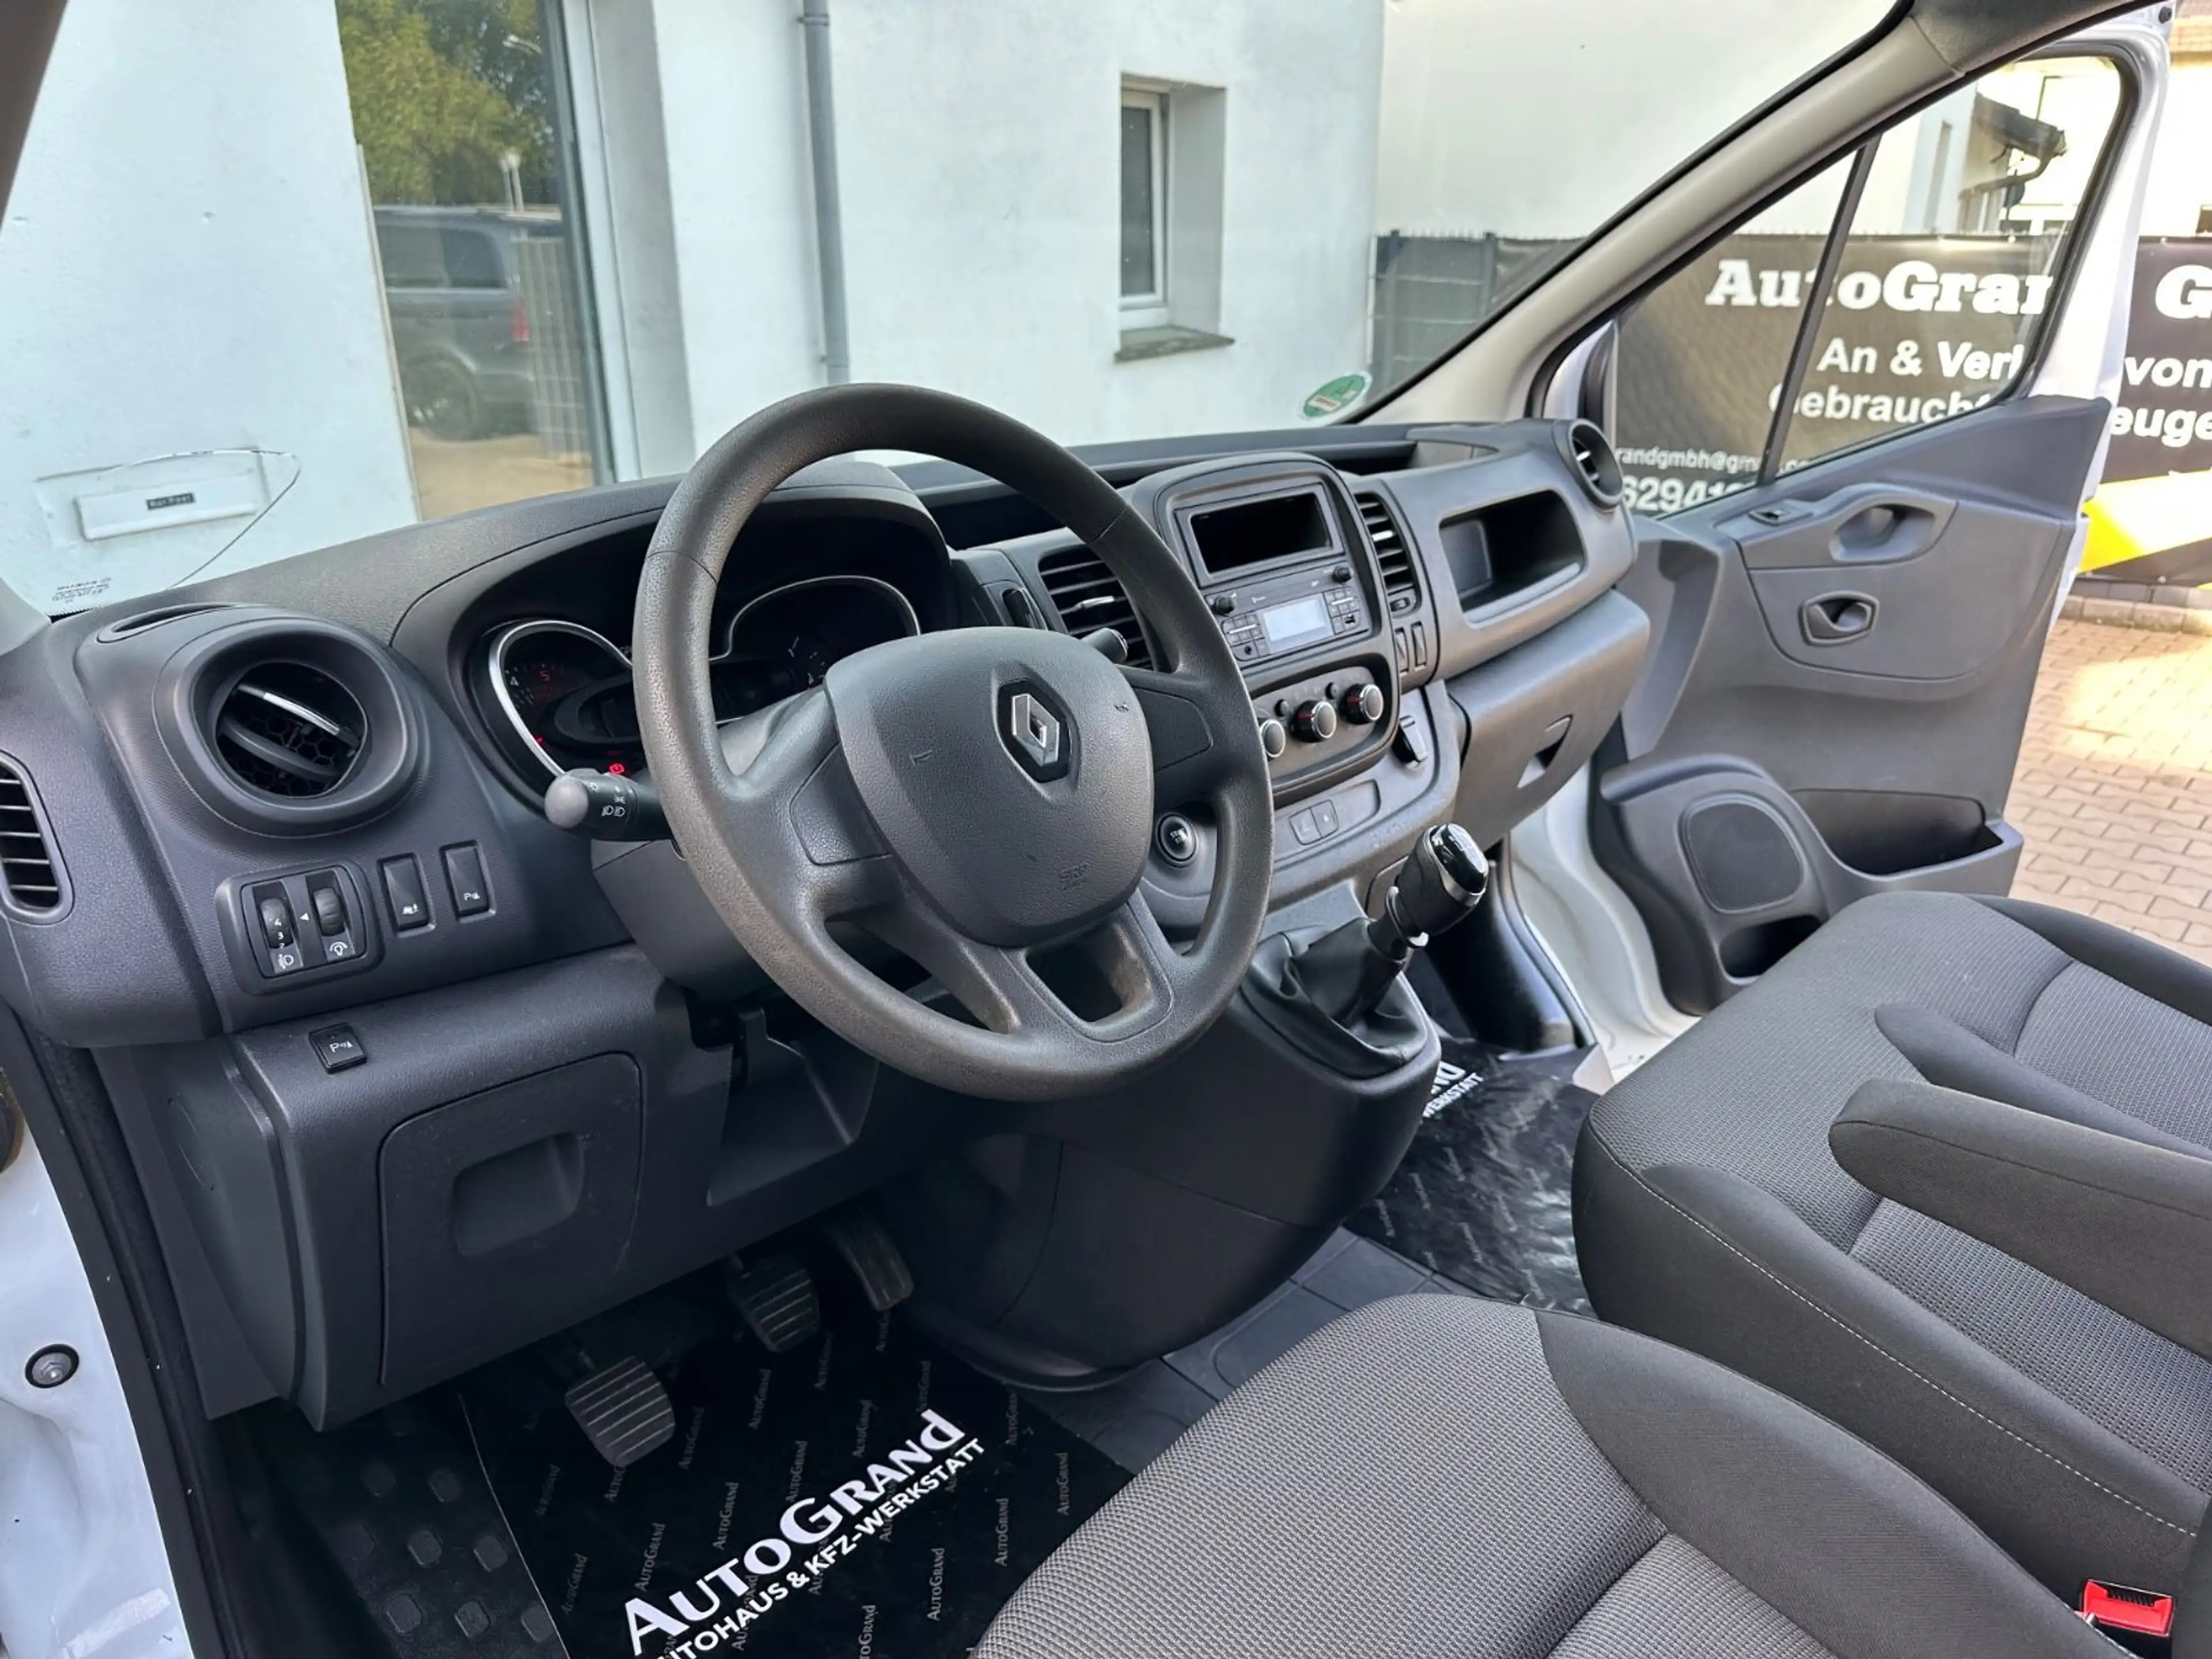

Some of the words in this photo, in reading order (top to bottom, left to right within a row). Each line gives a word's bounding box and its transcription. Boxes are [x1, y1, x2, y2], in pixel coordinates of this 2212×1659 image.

[1817, 336, 1878, 373] An
[1889, 340, 1923, 376] &
[785, 1571, 810, 1589] &
[803, 1437, 985, 1576] KFZ-WERKSTATT
